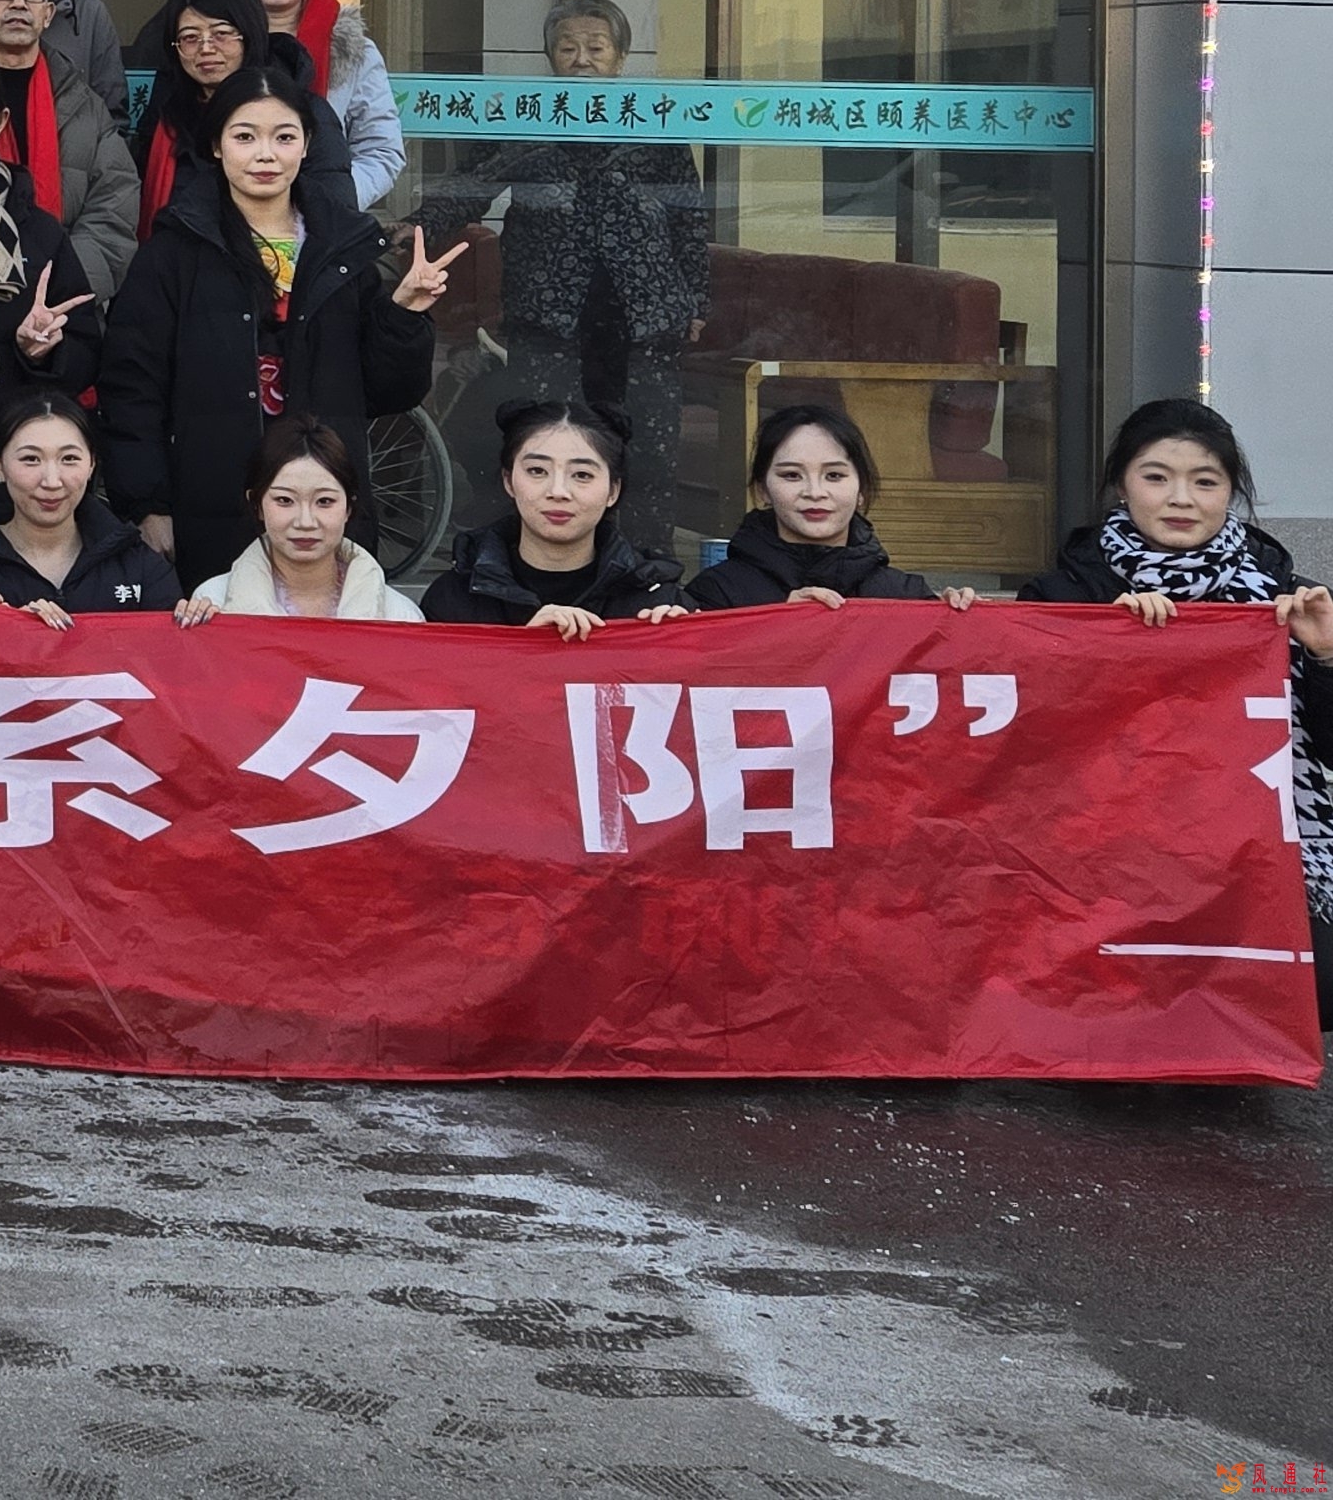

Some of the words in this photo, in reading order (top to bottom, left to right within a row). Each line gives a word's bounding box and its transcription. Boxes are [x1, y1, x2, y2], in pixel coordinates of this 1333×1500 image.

[413, 90, 713, 130] 朔城区颐养医养中心
[773, 98, 1075, 135] 朔城区颐养医养中心
